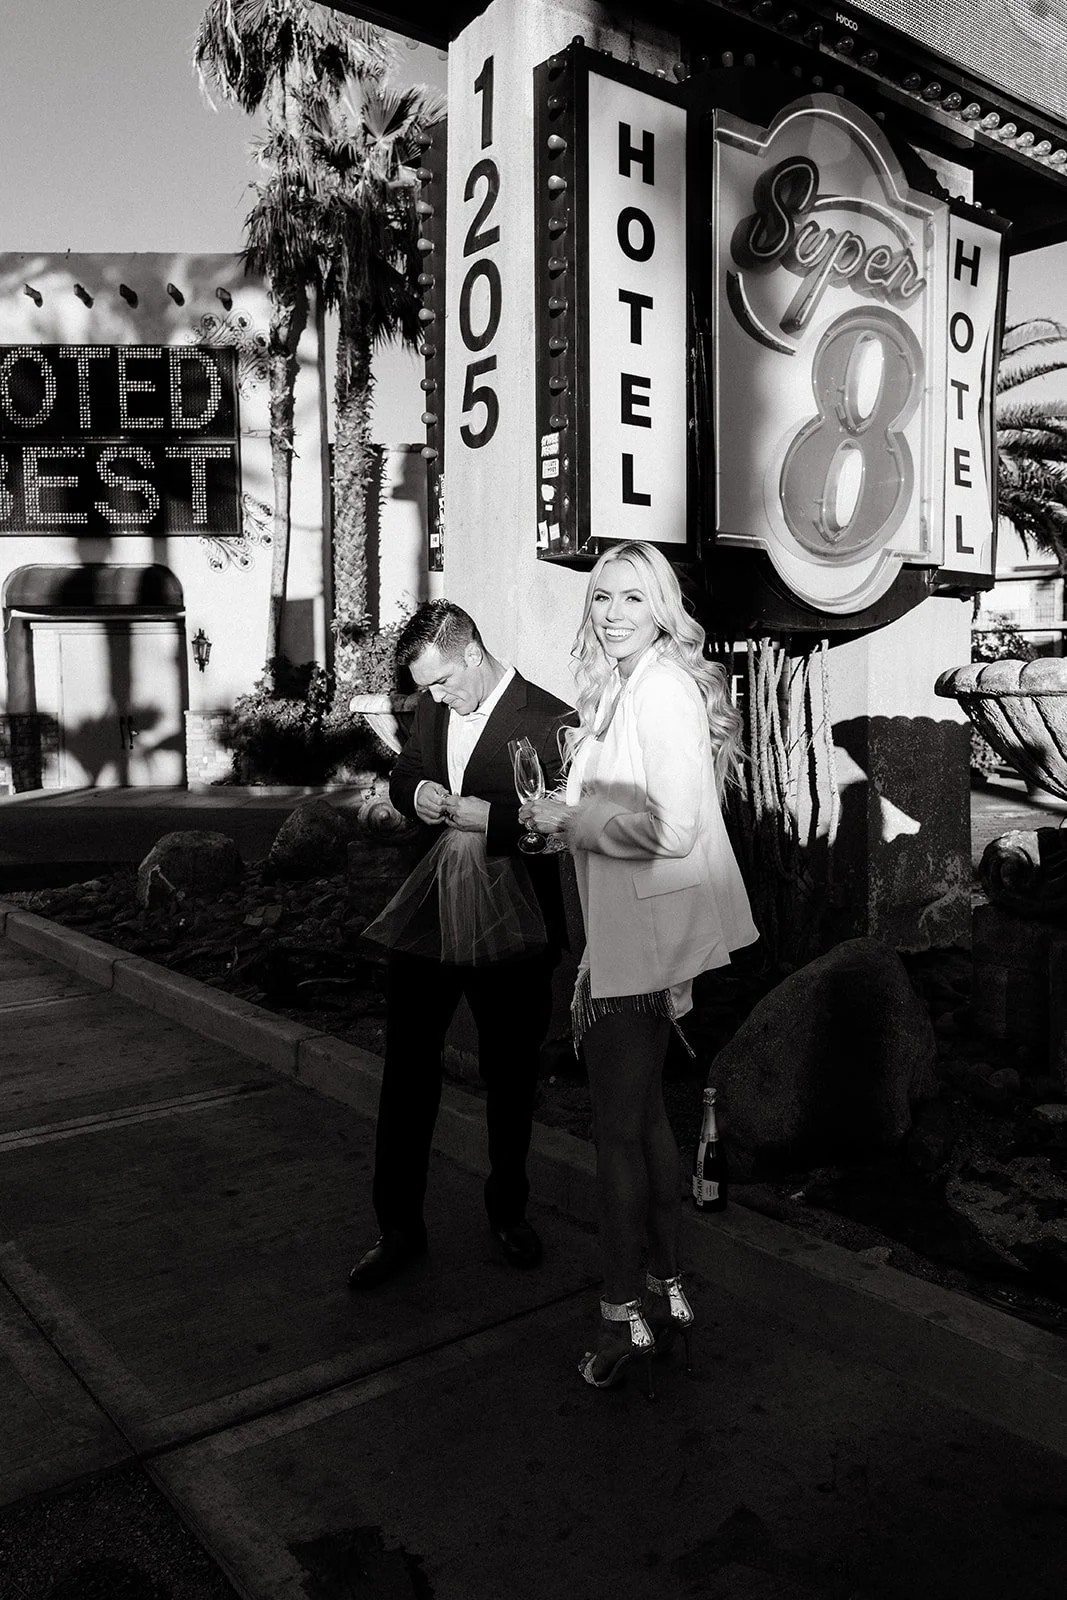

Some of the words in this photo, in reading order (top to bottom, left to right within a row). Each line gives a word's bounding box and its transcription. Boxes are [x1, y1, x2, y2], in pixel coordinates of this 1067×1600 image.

[459, 55, 502, 449] 1205
[617, 121, 656, 507] HOTEL
[730, 155, 927, 339] Super
[949, 239, 979, 554] HOTEL
[779, 304, 925, 562] 8
